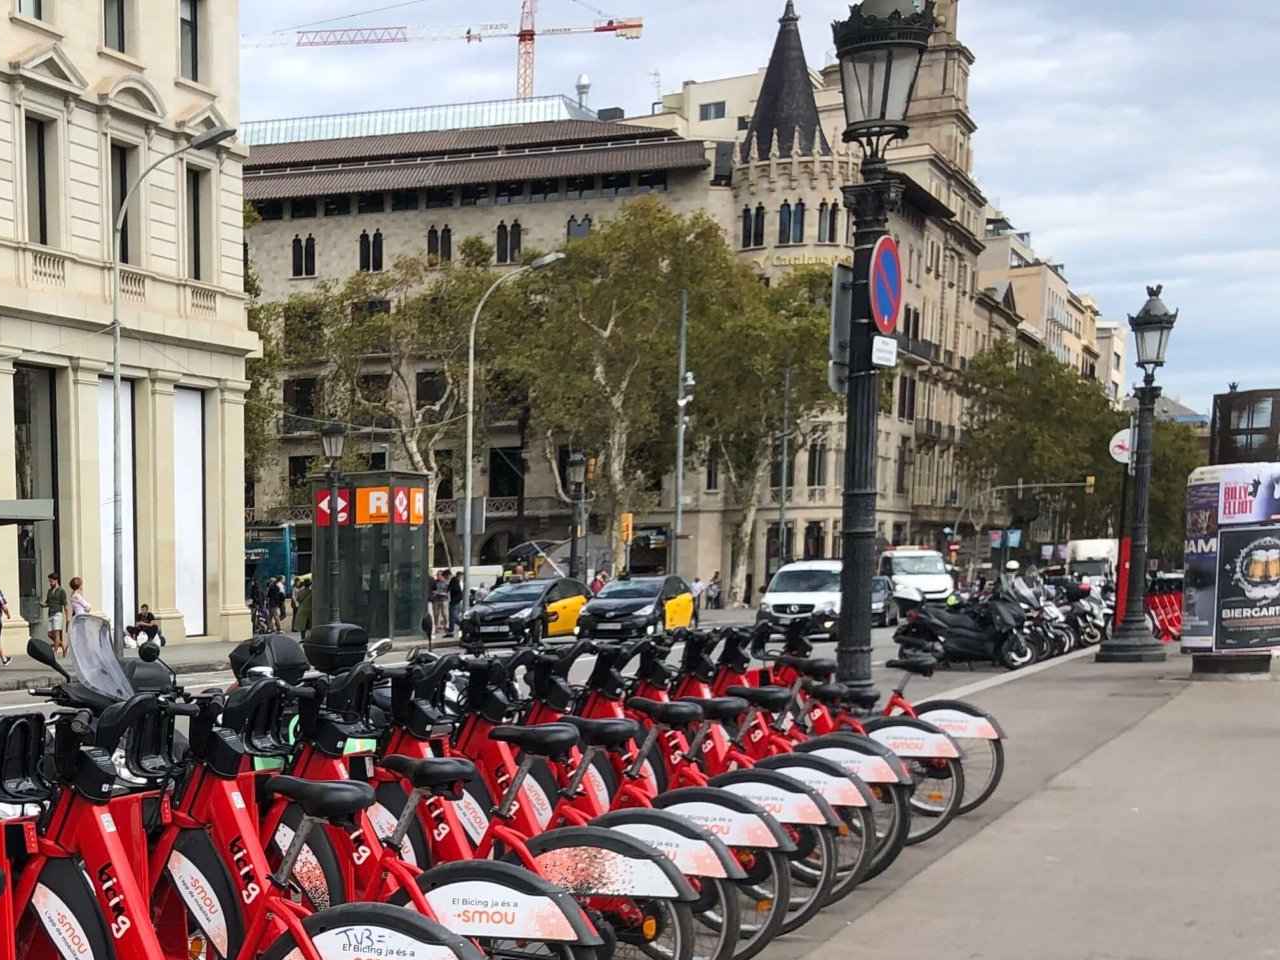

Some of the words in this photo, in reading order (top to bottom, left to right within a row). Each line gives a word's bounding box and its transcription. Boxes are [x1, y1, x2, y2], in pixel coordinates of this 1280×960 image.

[1224, 486, 1249, 500] BILLY
[369, 491, 388, 514] R
[1223, 500, 1253, 515] ELLIOT
[229, 834, 261, 904] bicing
[97, 862, 131, 939] bicing
[191, 879, 218, 914] smou
[461, 898, 489, 908] Bicing
[490, 900, 499, 909] ja
[500, 899, 511, 908] és
[462, 910, 515, 925] smou
[55, 927, 62, 936] de
[57, 914, 88, 954] smou
[342, 943, 351, 951] El
[353, 944, 383, 956] Bicing
[384, 946, 394, 956] ja
[396, 947, 407, 957] és
